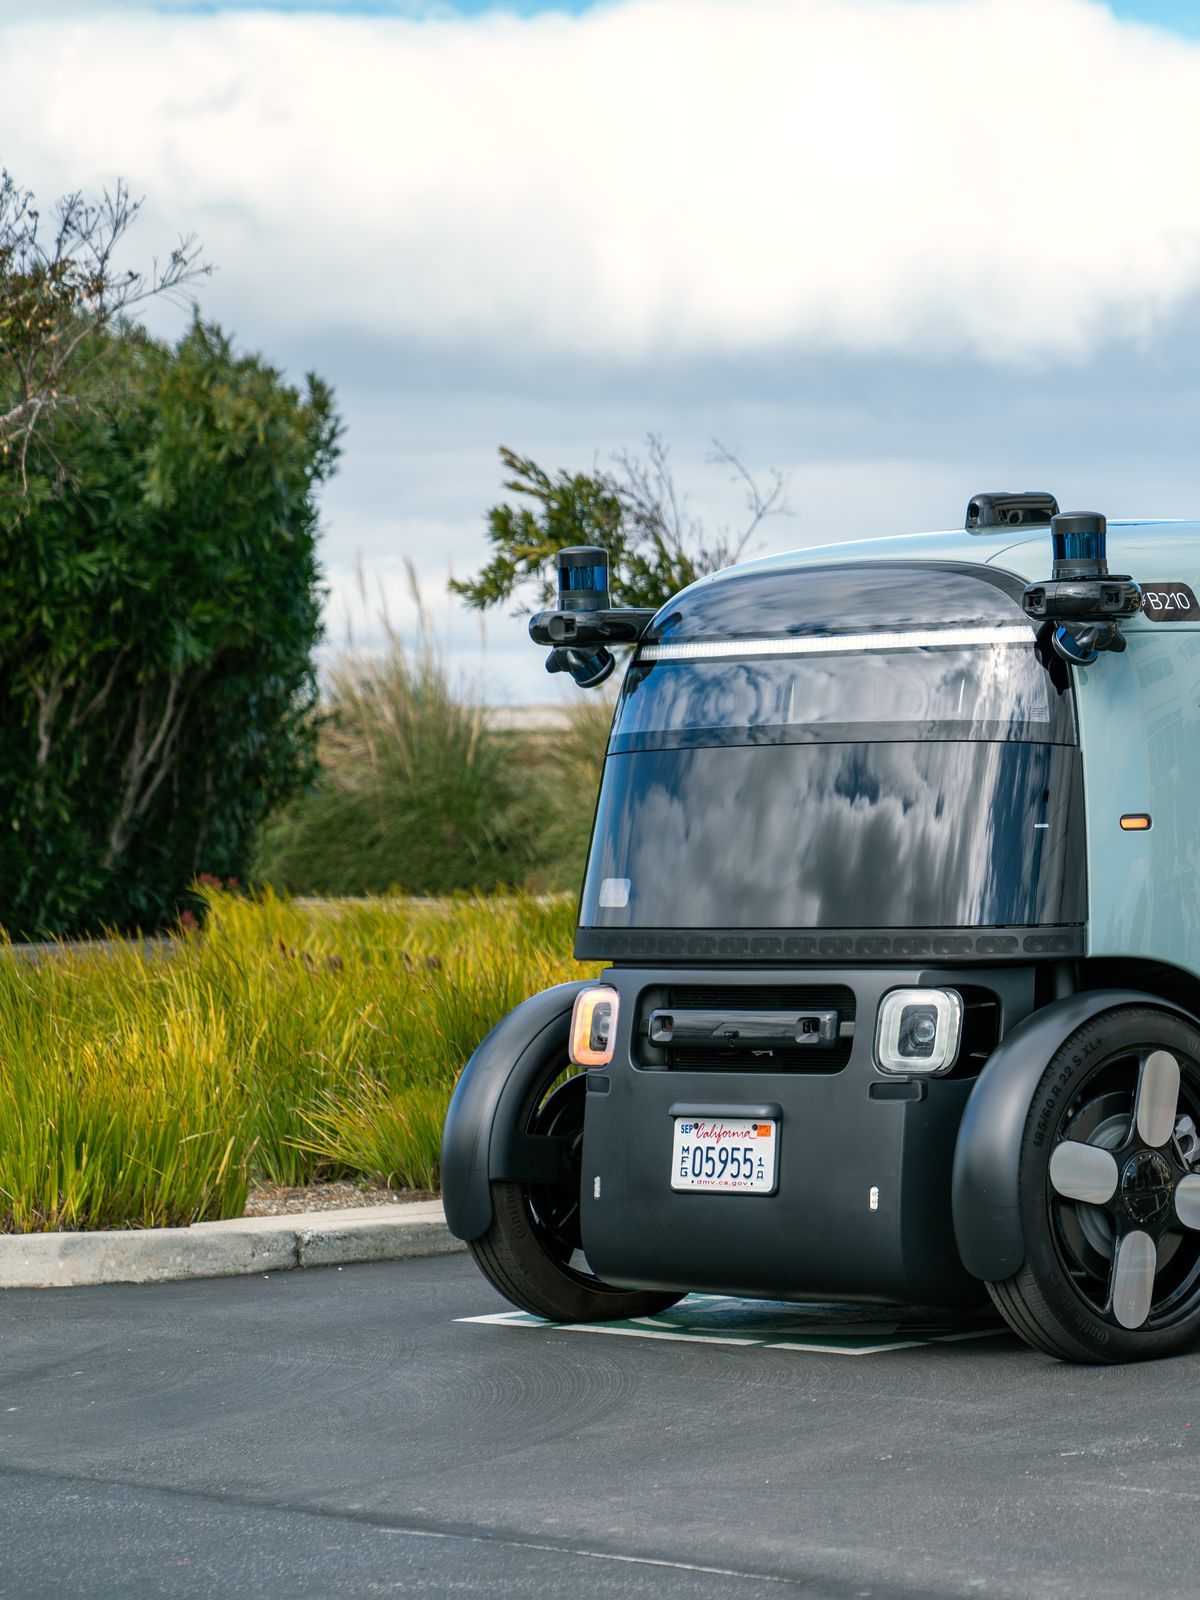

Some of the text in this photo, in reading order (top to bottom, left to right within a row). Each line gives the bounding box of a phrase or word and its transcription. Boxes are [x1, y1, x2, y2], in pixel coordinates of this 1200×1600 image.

[1146, 592, 1191, 610] B210
[1051, 1084, 1062, 1098] R
[1059, 1066, 1075, 1085] 22
[1072, 1055, 1082, 1067] S
[680, 1122, 758, 1144] SEP California
[692, 1146, 754, 1179] 05955
[697, 1179, 748, 1187] dmv.ca.gov
